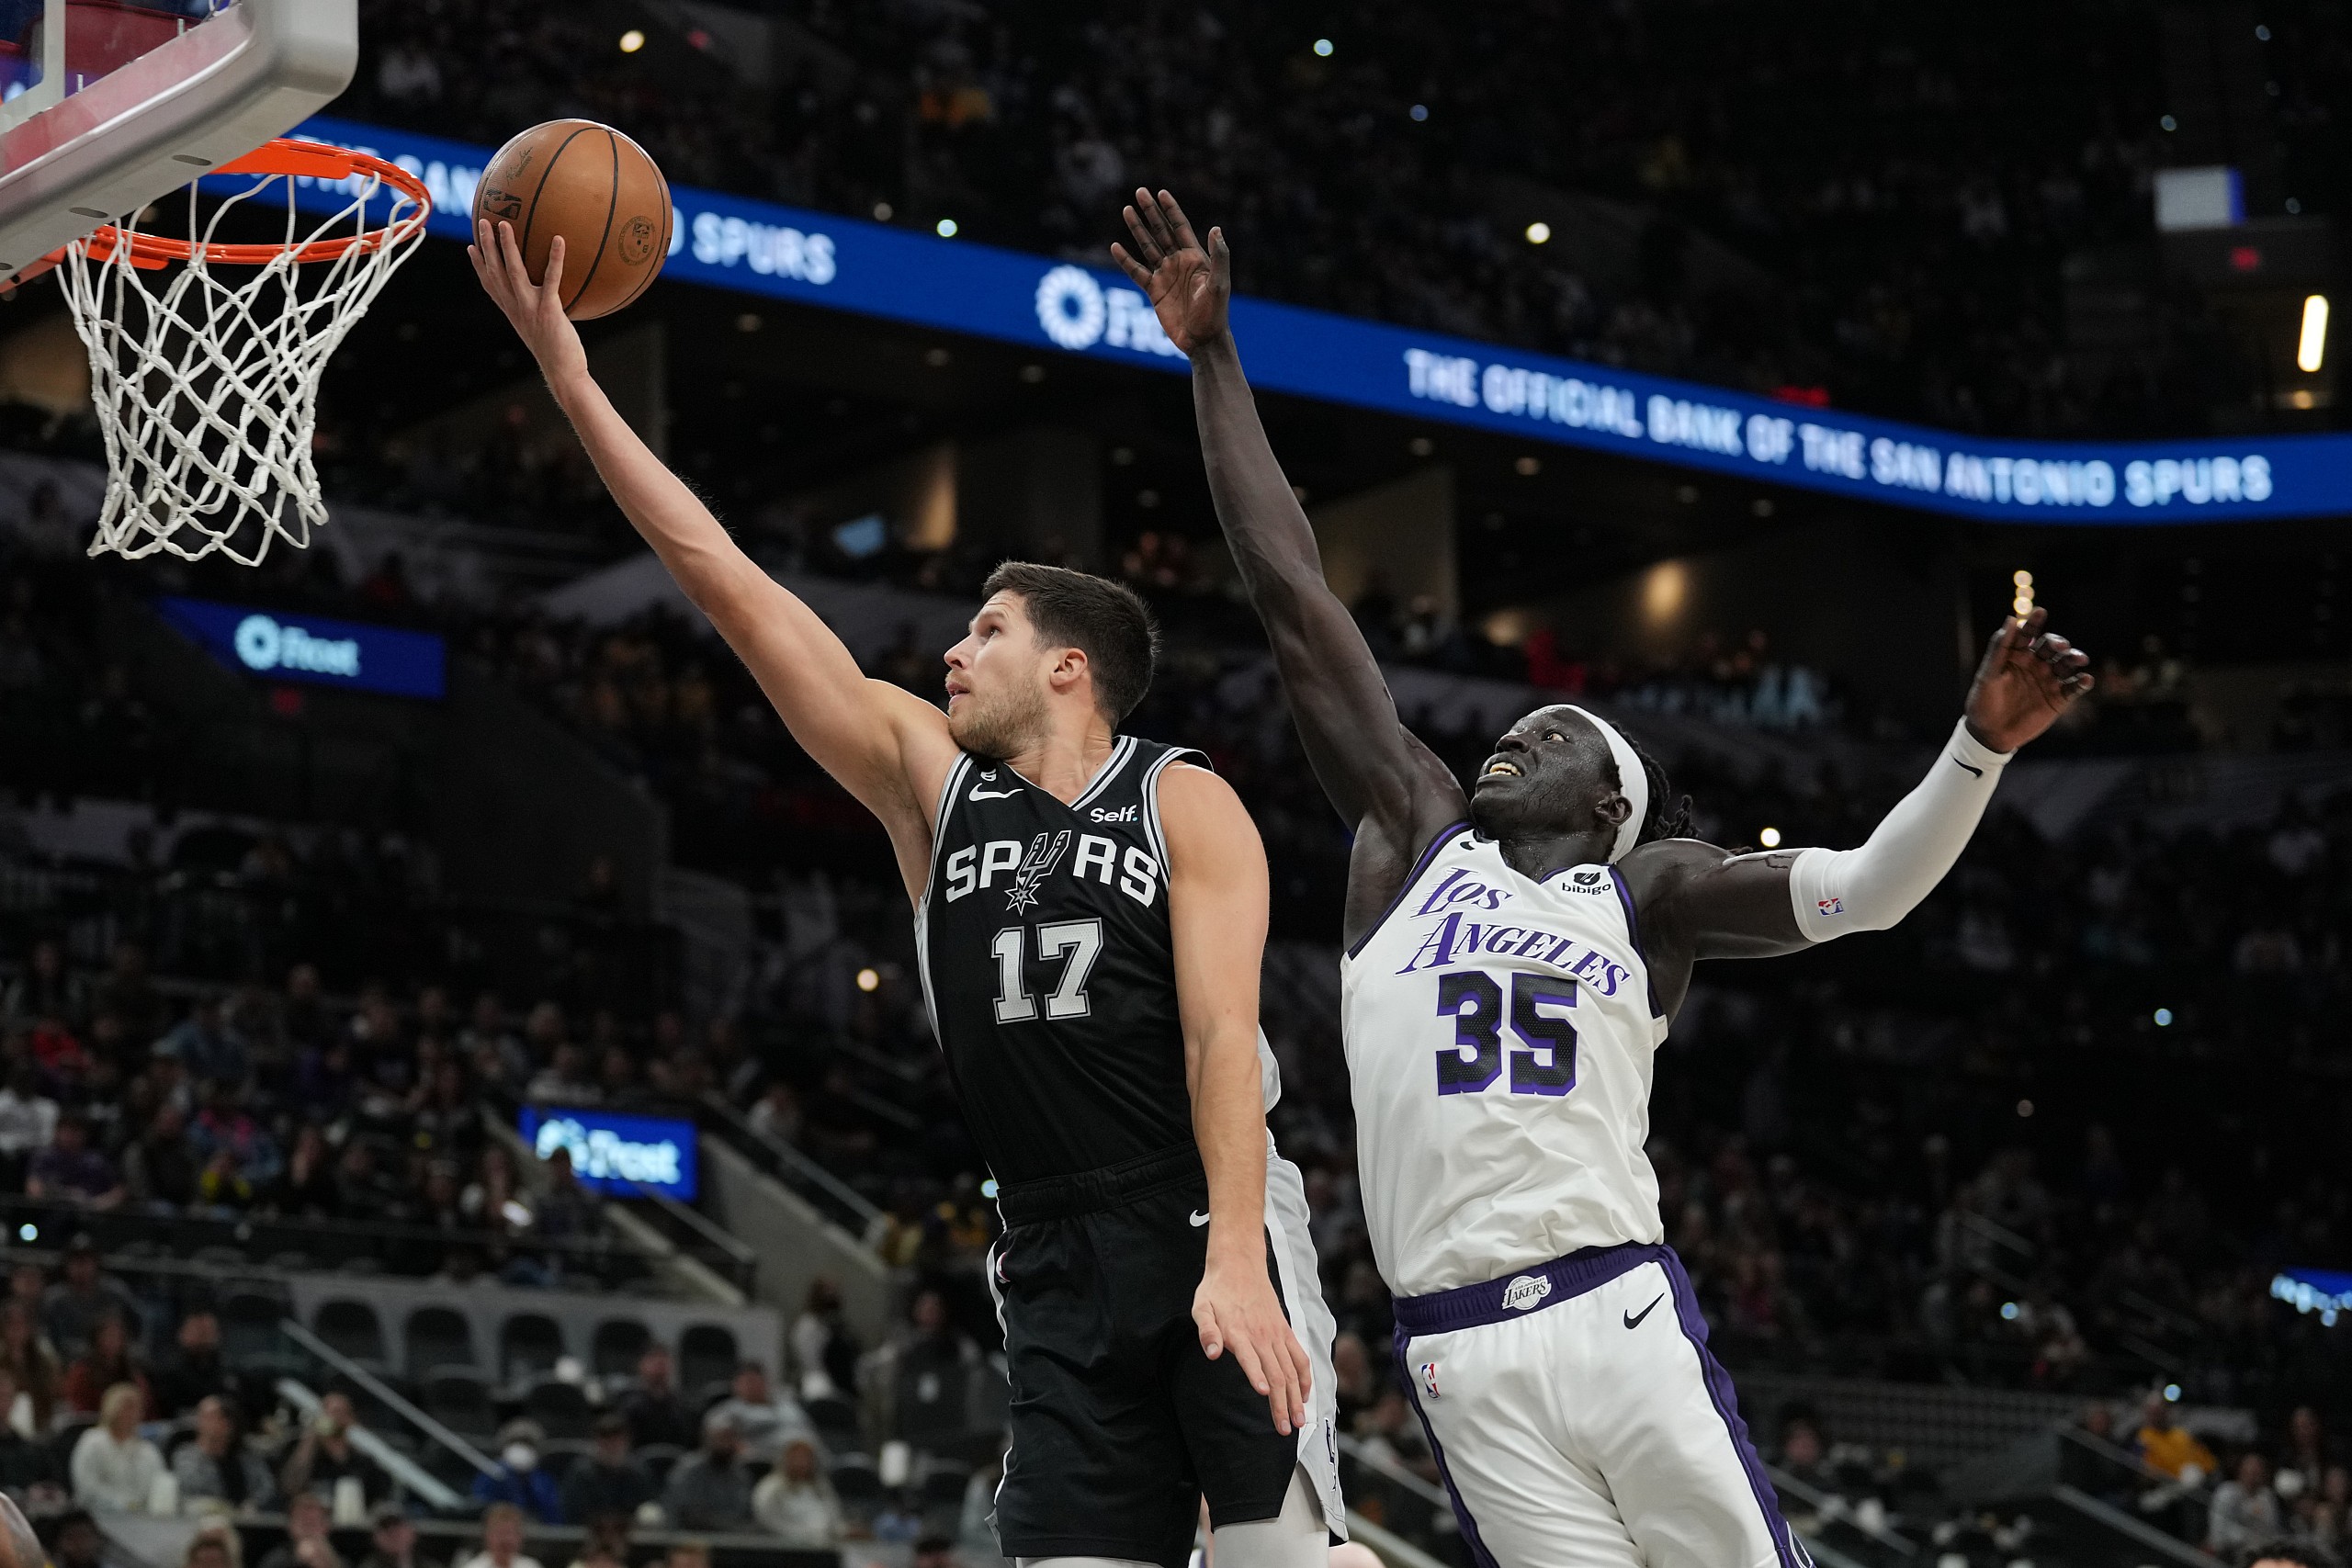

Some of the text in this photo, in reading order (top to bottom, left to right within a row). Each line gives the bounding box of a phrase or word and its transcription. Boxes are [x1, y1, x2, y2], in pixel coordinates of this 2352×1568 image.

[693, 212, 836, 286] SPURS
[1405, 347, 2272, 506] THE OFFICIAL BANK OF THE SAN ANTONIO SPURS
[1562, 883, 1611, 896] bibigo
[990, 917, 1103, 1025] 17
[1436, 970, 1577, 1097] 35
[1504, 1281, 1547, 1307] LAKERS
